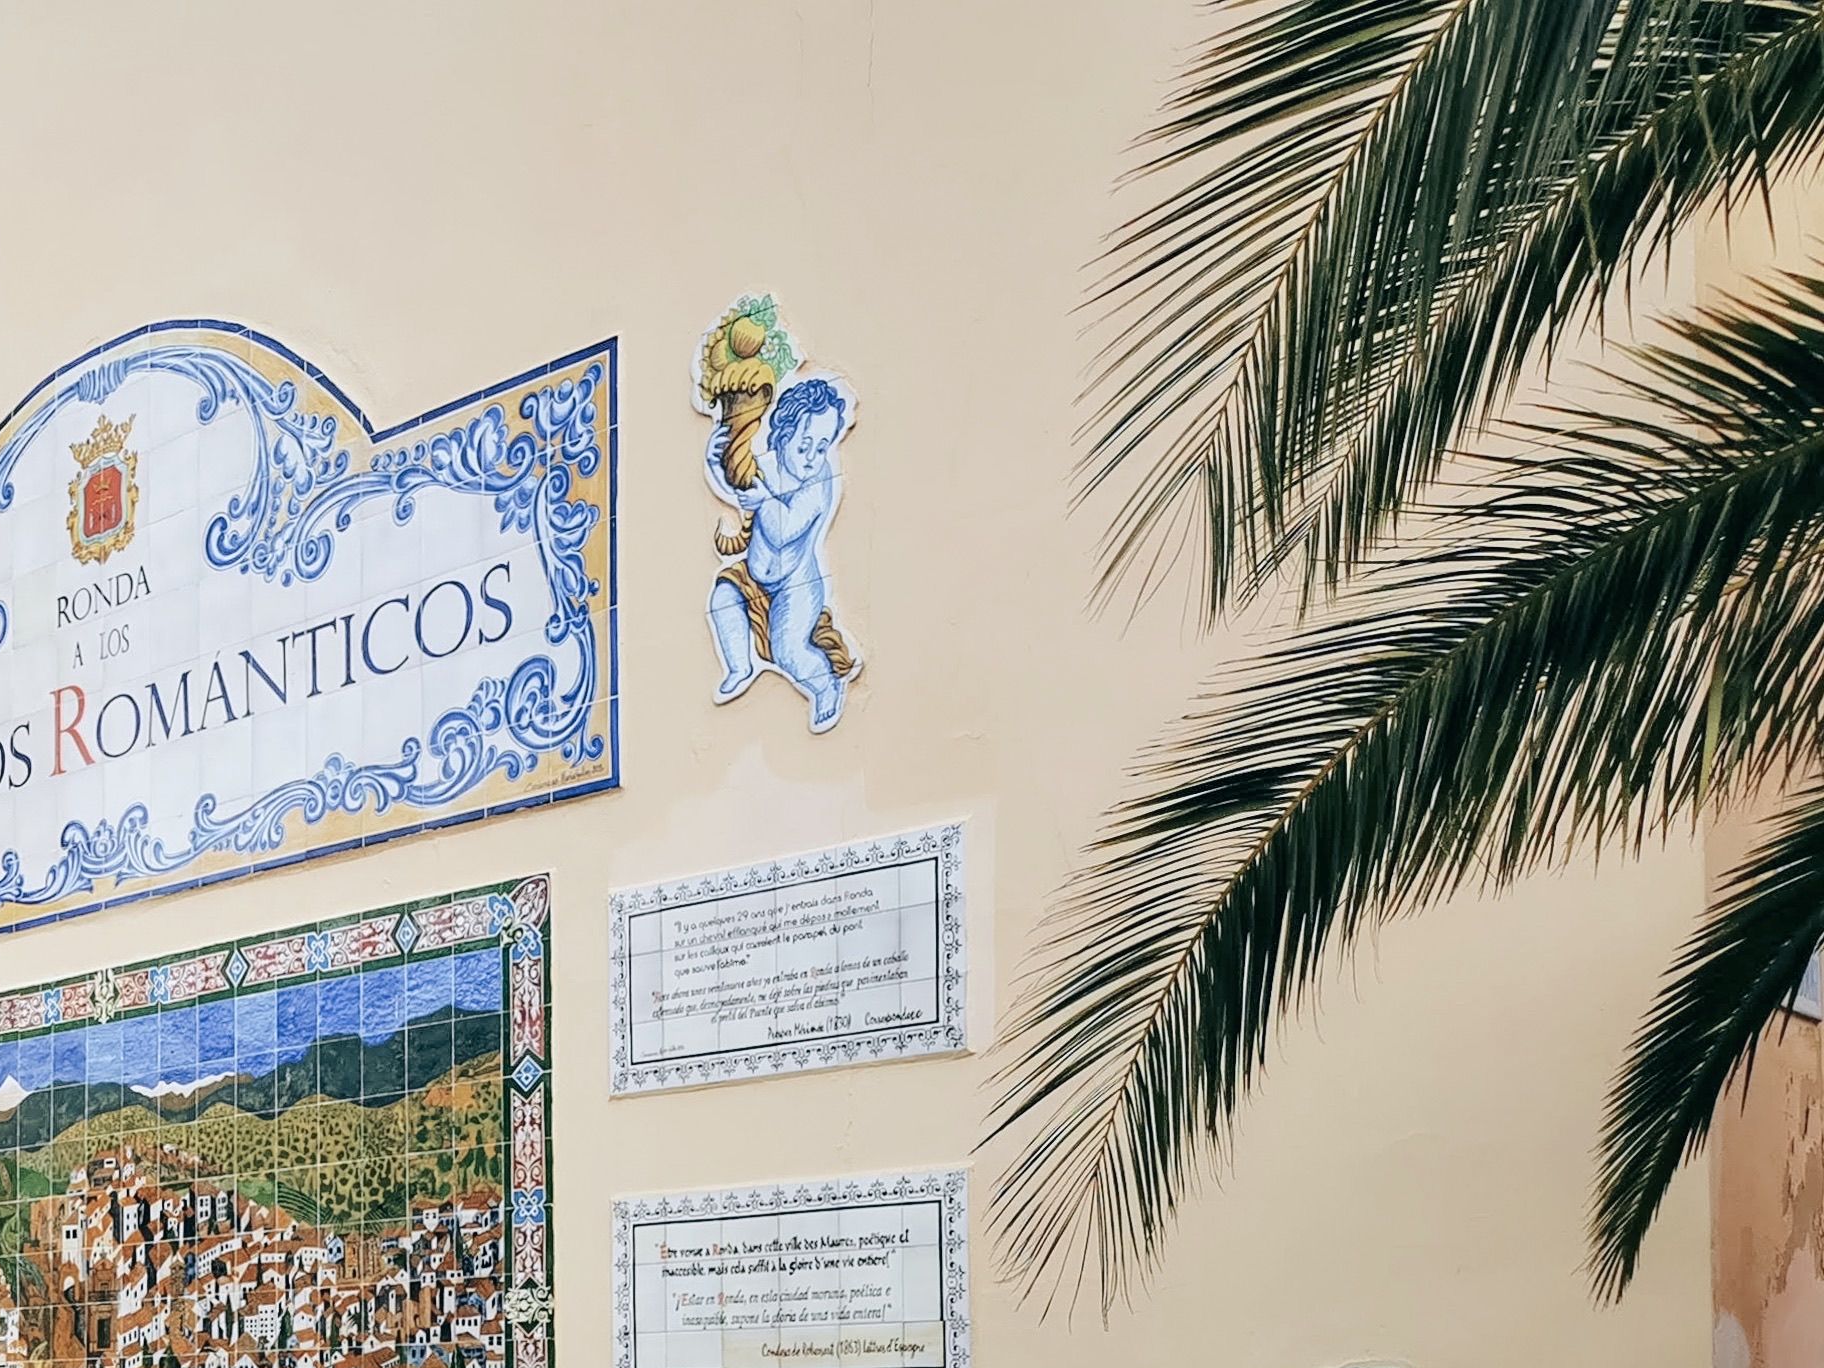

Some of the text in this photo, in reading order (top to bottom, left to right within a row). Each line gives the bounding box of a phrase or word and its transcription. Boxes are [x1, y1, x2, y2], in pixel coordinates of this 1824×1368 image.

[55, 564, 152, 628] RONDA
[49, 560, 514, 778] ROMÁNTICOS
[71, 624, 131, 669] A LOS
